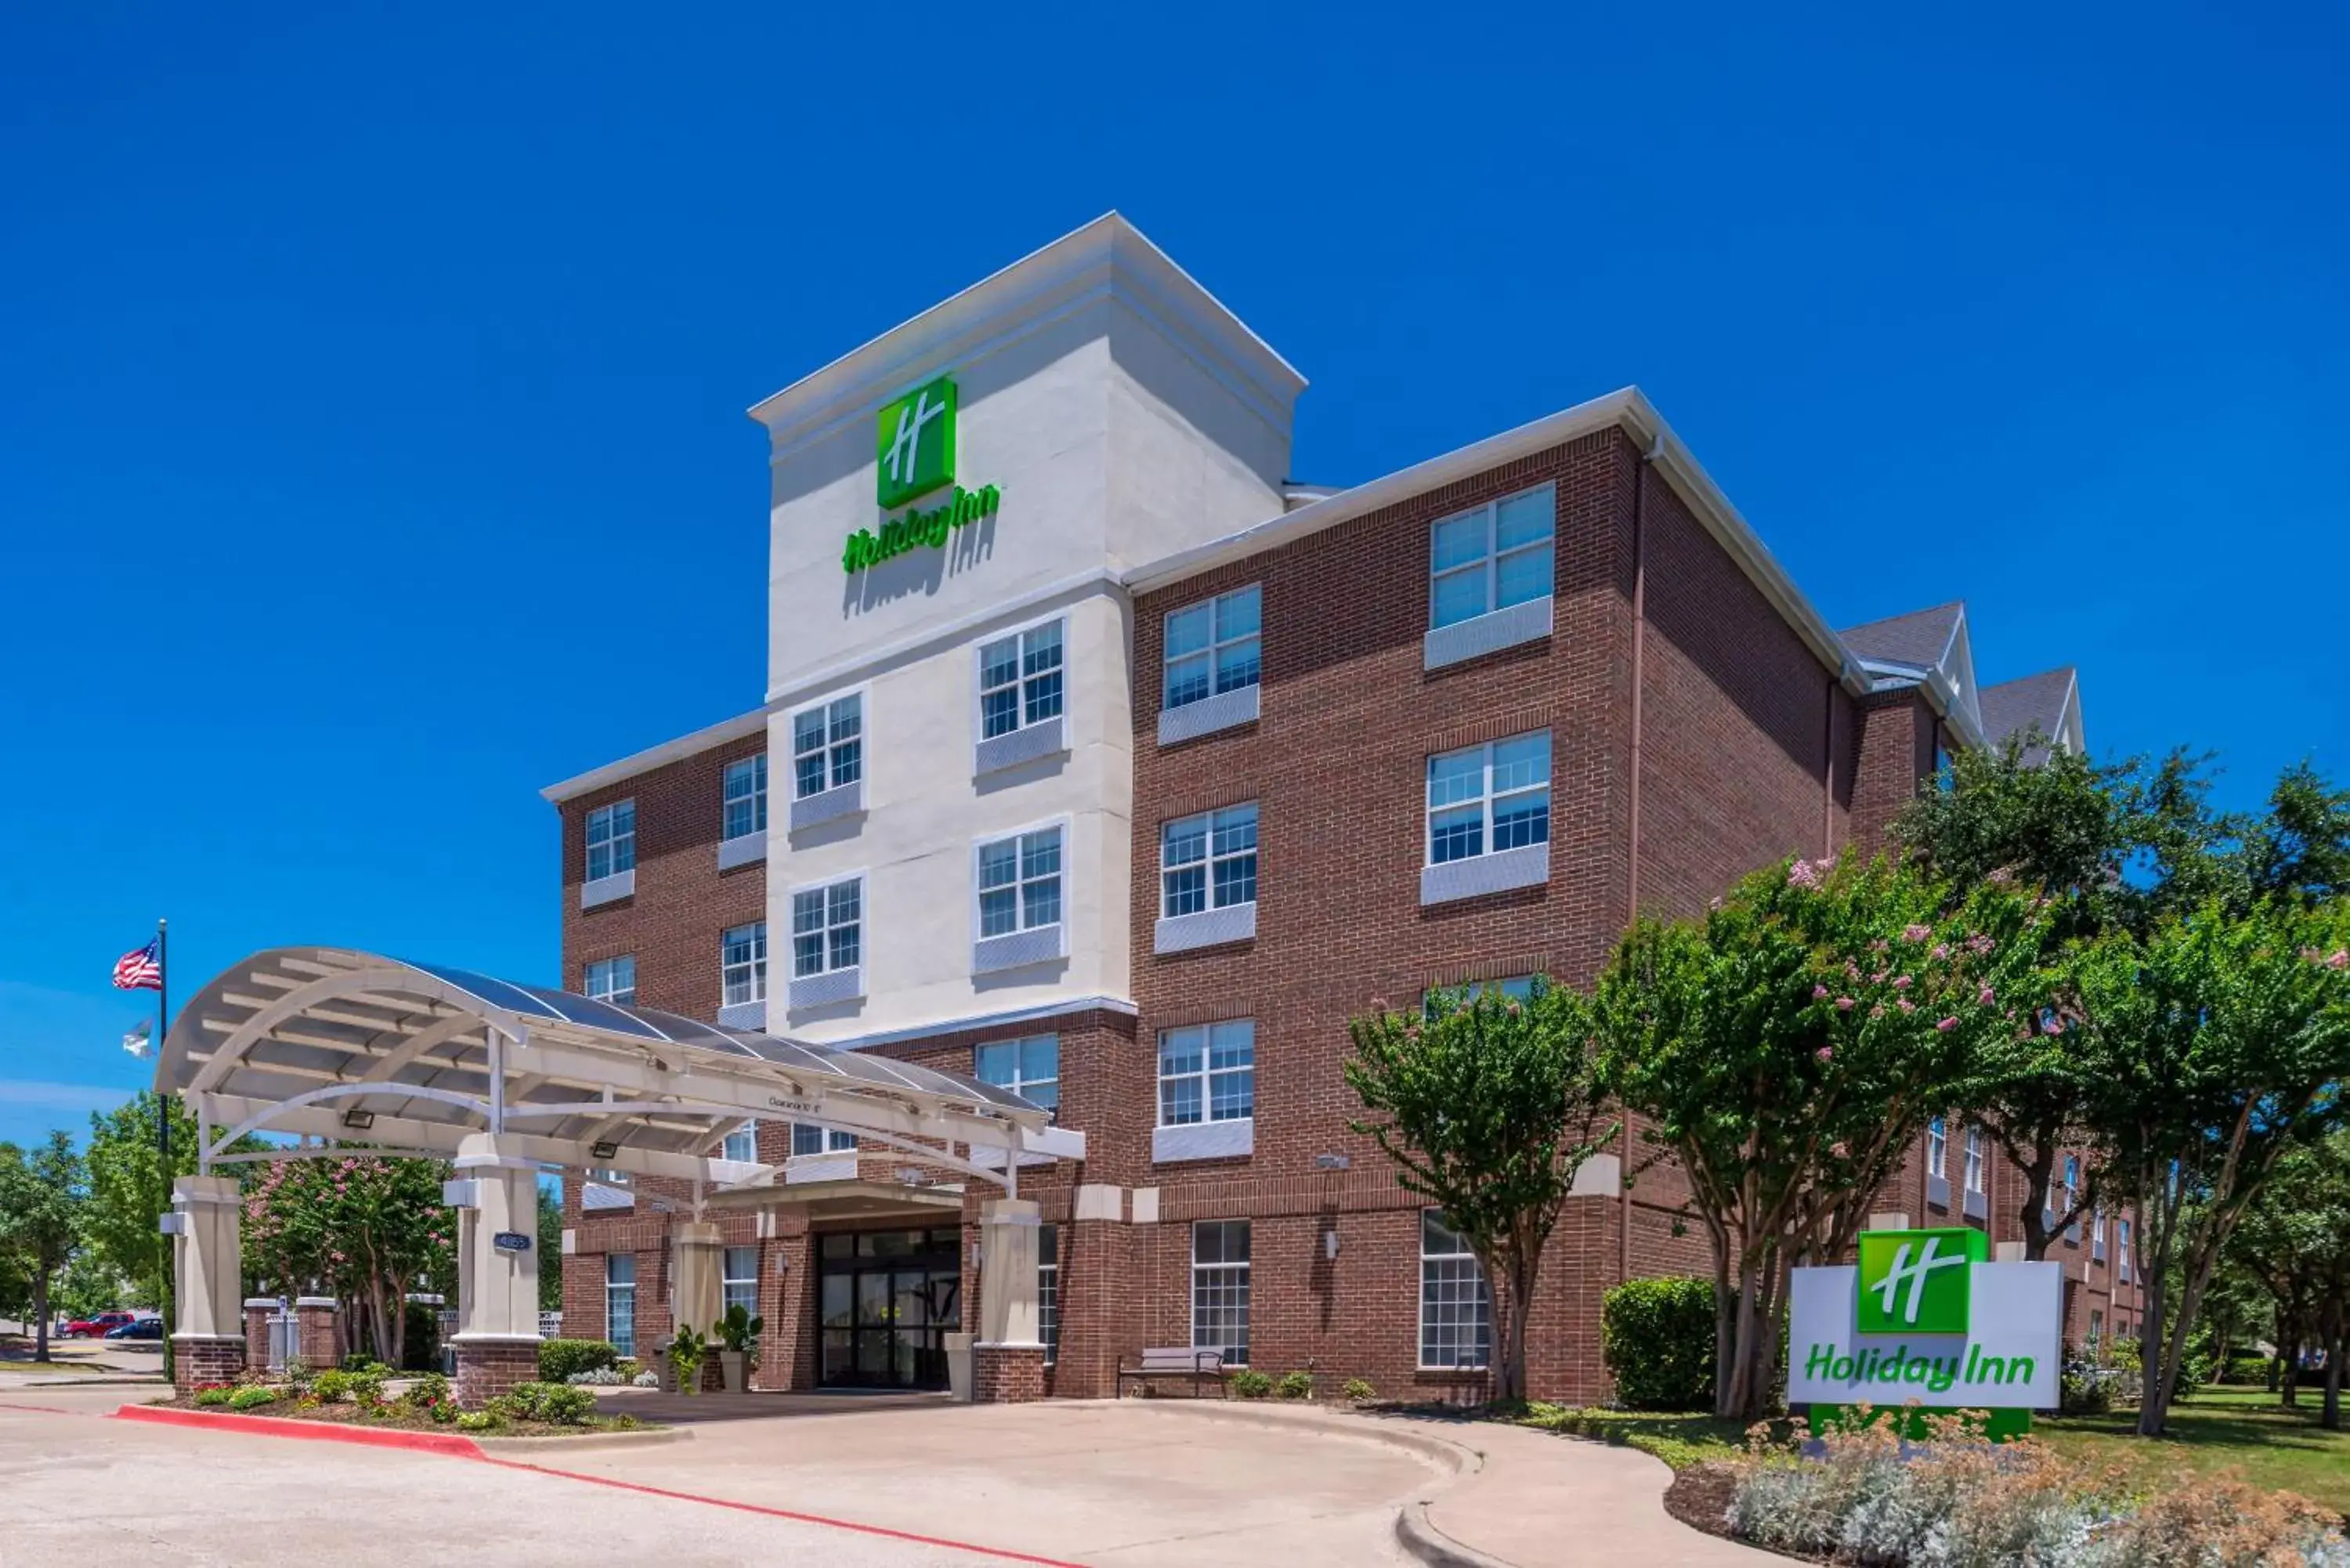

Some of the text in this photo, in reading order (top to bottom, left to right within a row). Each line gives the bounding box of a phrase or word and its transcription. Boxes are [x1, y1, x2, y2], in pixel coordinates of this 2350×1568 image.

[843, 484, 1000, 574] Holiday Inn
[1805, 1343, 2035, 1393] Holiday Inn
